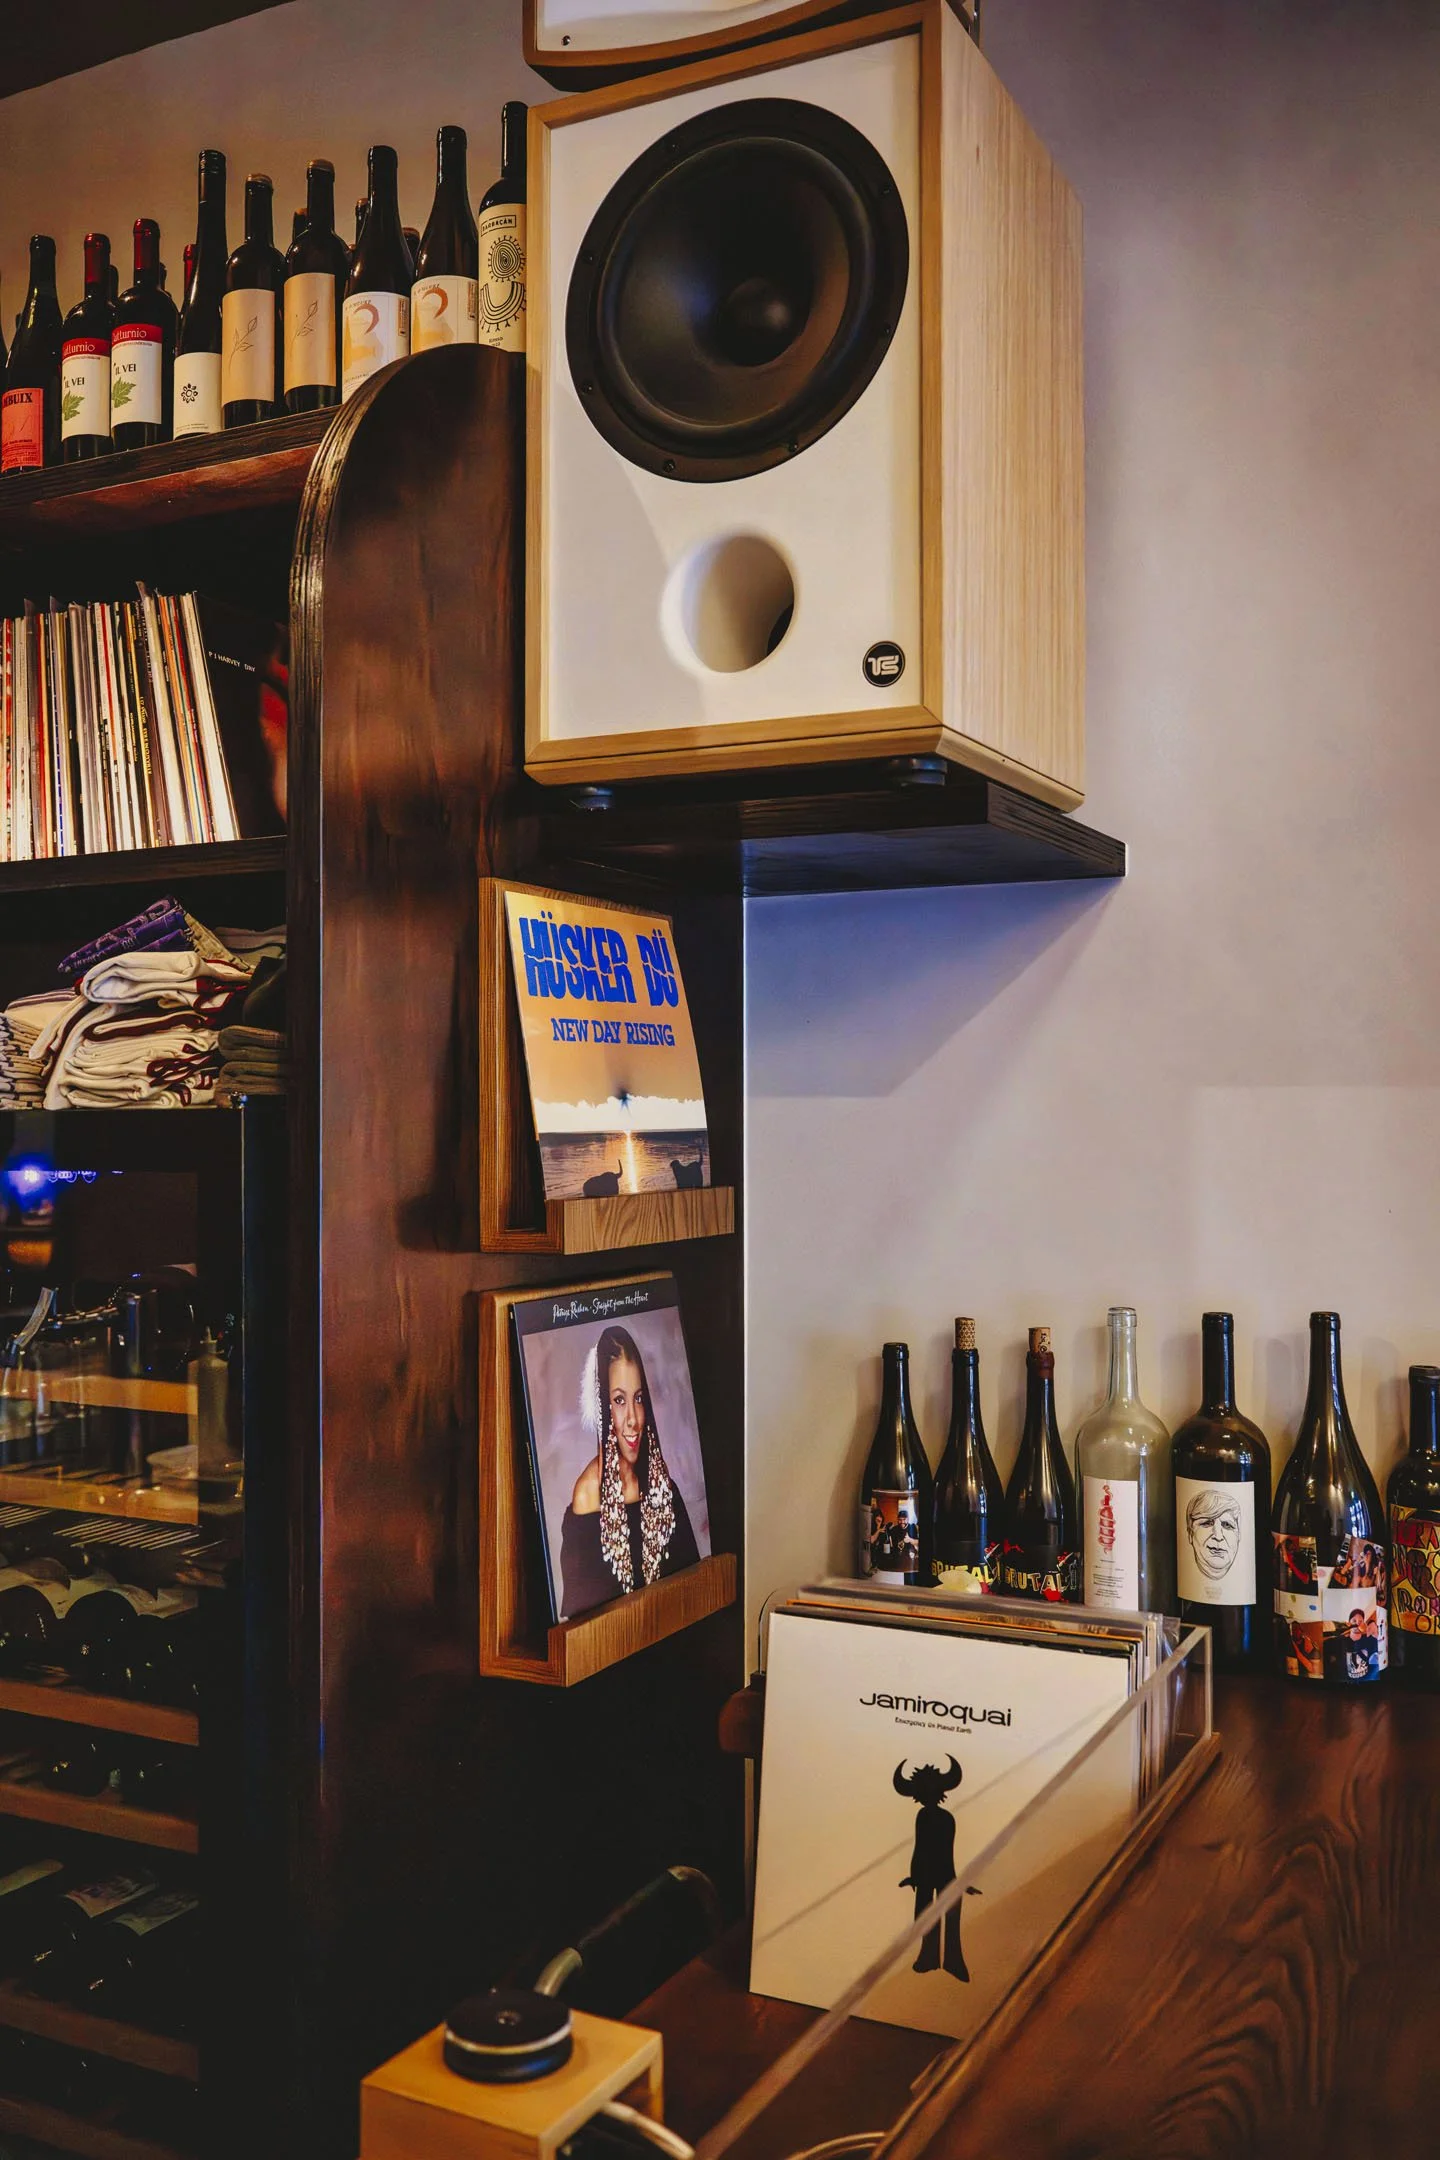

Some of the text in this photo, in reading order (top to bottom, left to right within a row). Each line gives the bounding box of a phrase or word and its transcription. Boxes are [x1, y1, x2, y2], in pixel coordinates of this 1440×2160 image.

[122, 363, 137, 373] VEI
[71, 376, 85, 387] VEI
[218, 654, 241, 668] HARVEY
[244, 663, 256, 673] DRY
[519, 910, 679, 1007] HÜSKER DÜ
[551, 1018, 675, 1046] NEW DAY RISING
[859, 1693, 1012, 1727] Jamiroquai
[894, 1716, 926, 1728] Emergency
[956, 1726, 972, 1734] Earth
